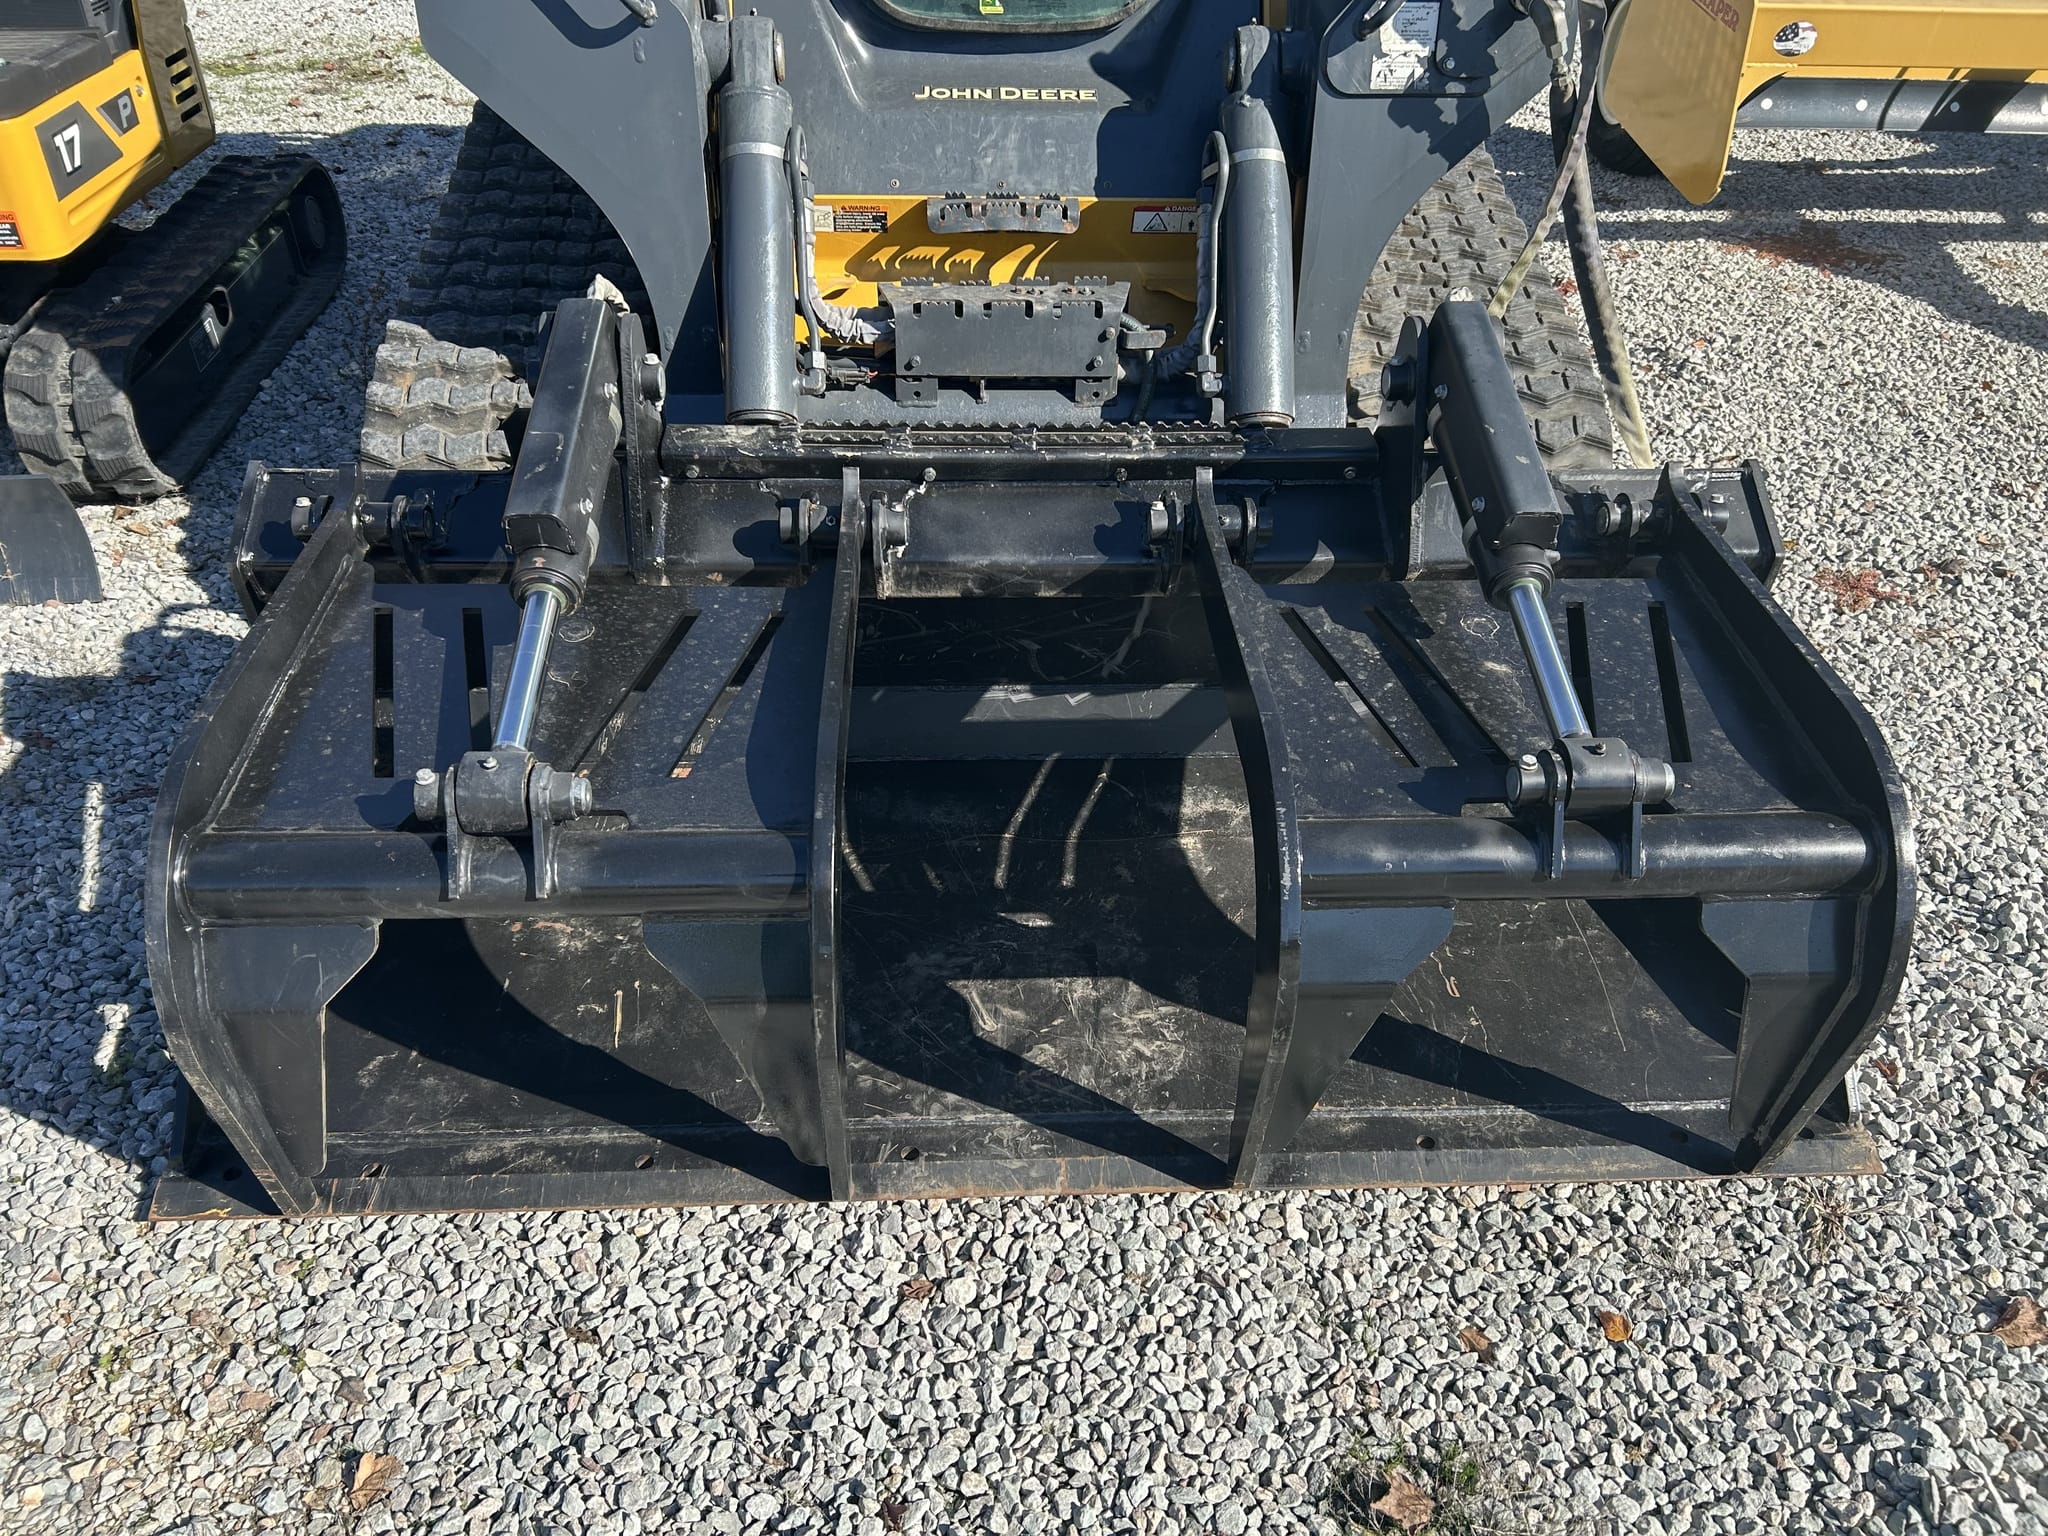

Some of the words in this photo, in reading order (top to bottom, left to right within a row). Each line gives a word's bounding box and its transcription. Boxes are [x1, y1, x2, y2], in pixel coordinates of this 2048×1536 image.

[914, 86, 993, 100] JOHN
[1000, 87, 1097, 101] DEERE
[117, 95, 132, 129] P
[53, 122, 81, 173] 17
